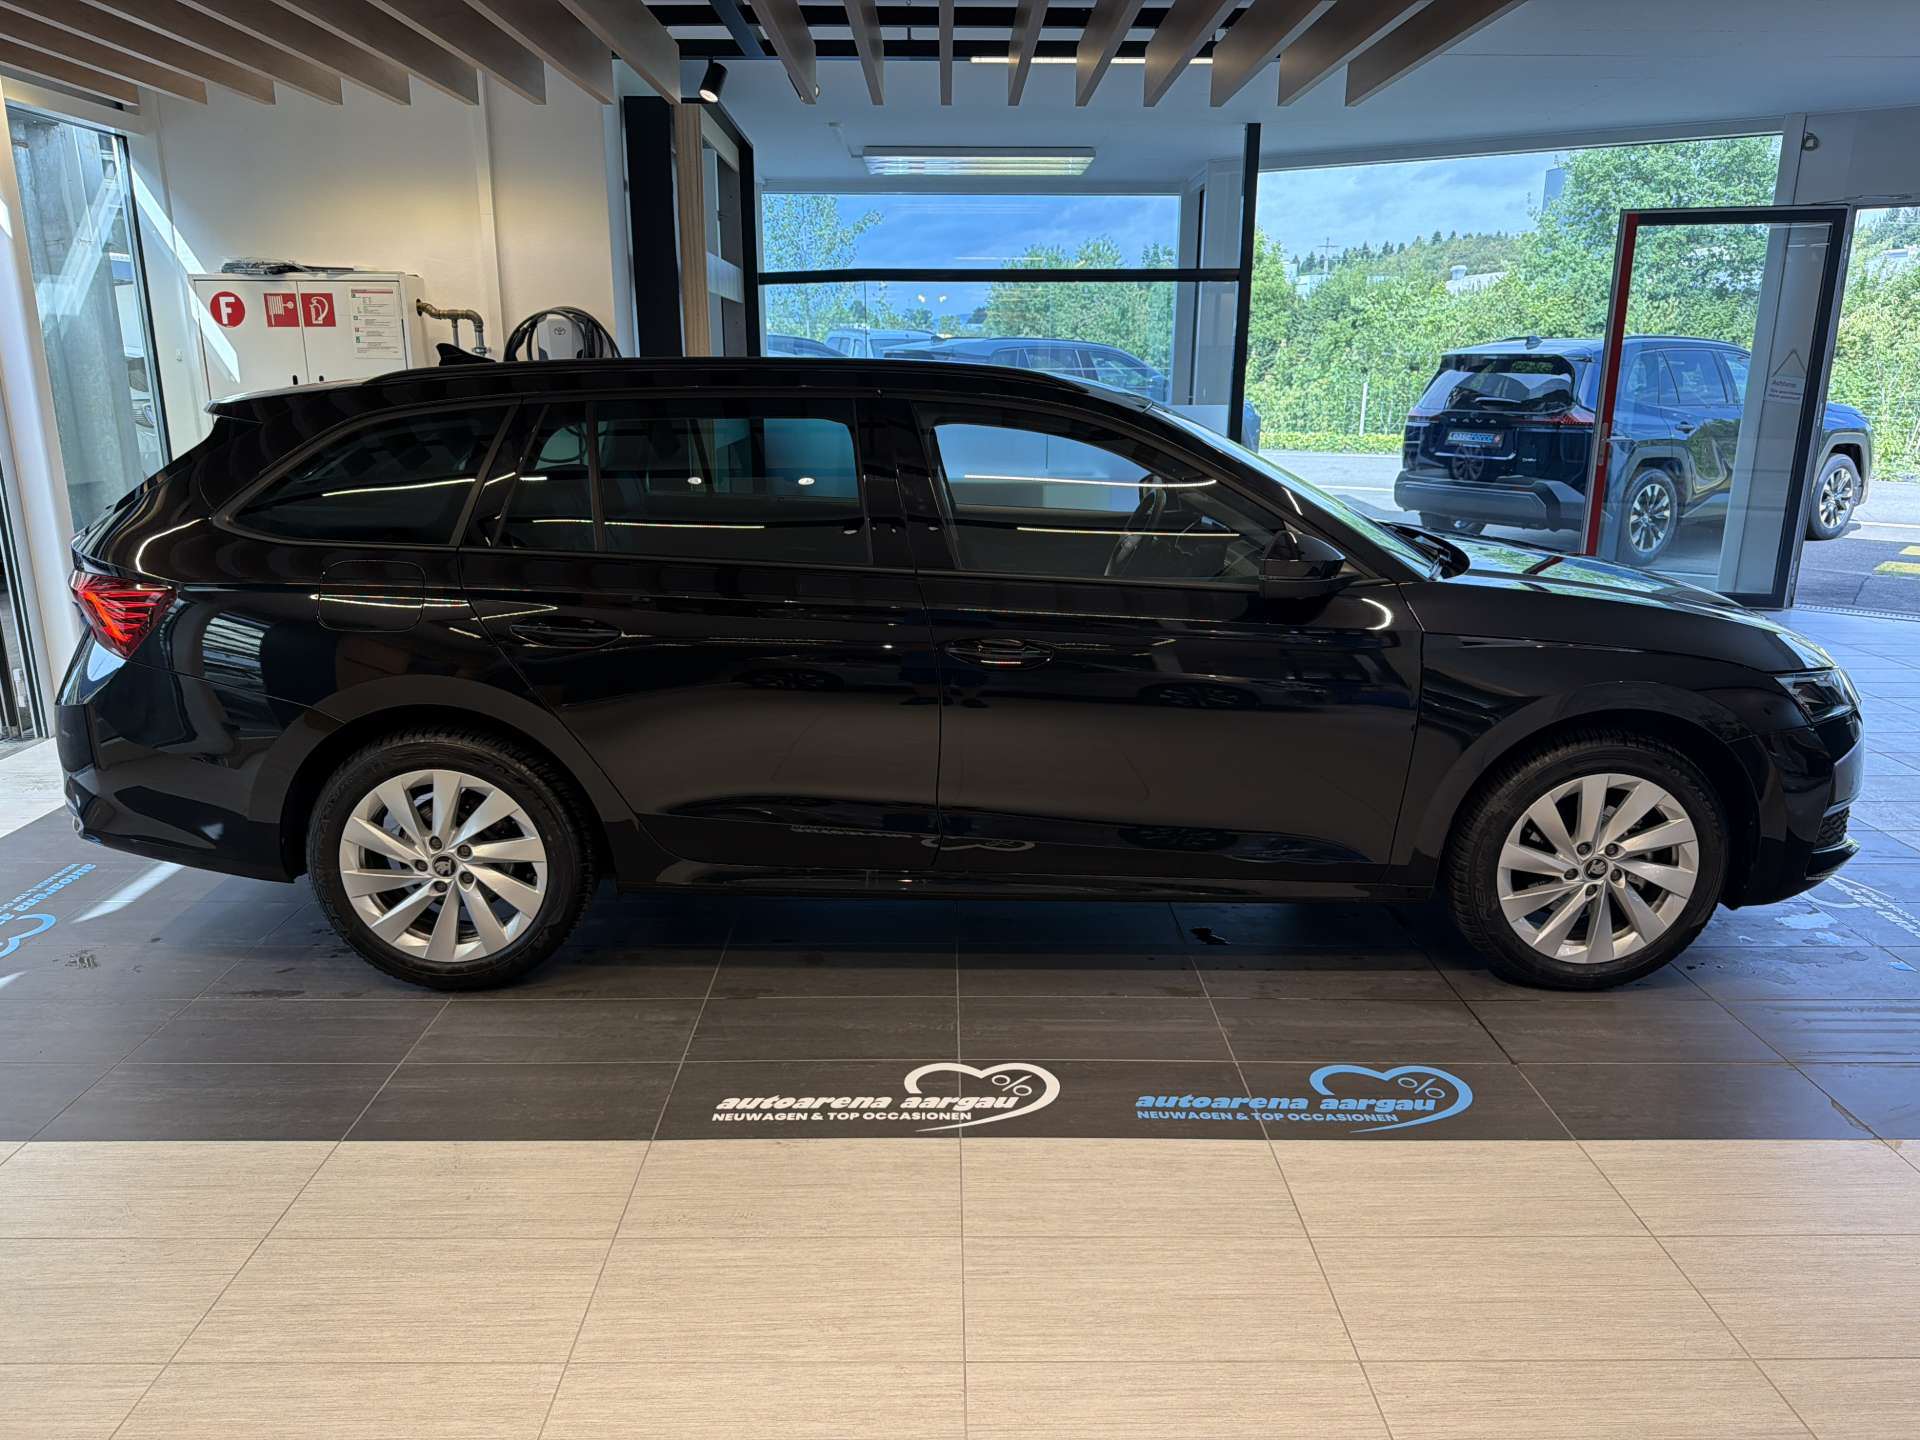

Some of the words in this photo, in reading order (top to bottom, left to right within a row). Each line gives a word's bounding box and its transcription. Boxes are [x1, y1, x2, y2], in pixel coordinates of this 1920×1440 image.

[218, 296, 235, 324] F
[715, 1094, 892, 1110] autoarena
[900, 1096, 1019, 1111] aargau
[1135, 1093, 1309, 1109] autoarena
[1319, 1098, 1437, 1112] aargau
[712, 1112, 808, 1121] NEUWAGEN
[811, 1112, 824, 1121] &
[828, 1112, 860, 1121] TOP
[863, 1111, 972, 1121] OCCASIONEN
[1136, 1111, 1233, 1121] NEUWAGEN
[1236, 1112, 1250, 1121] &
[1251, 1112, 1284, 1121] TOP
[1287, 1112, 1399, 1122] OCCASIONEN
